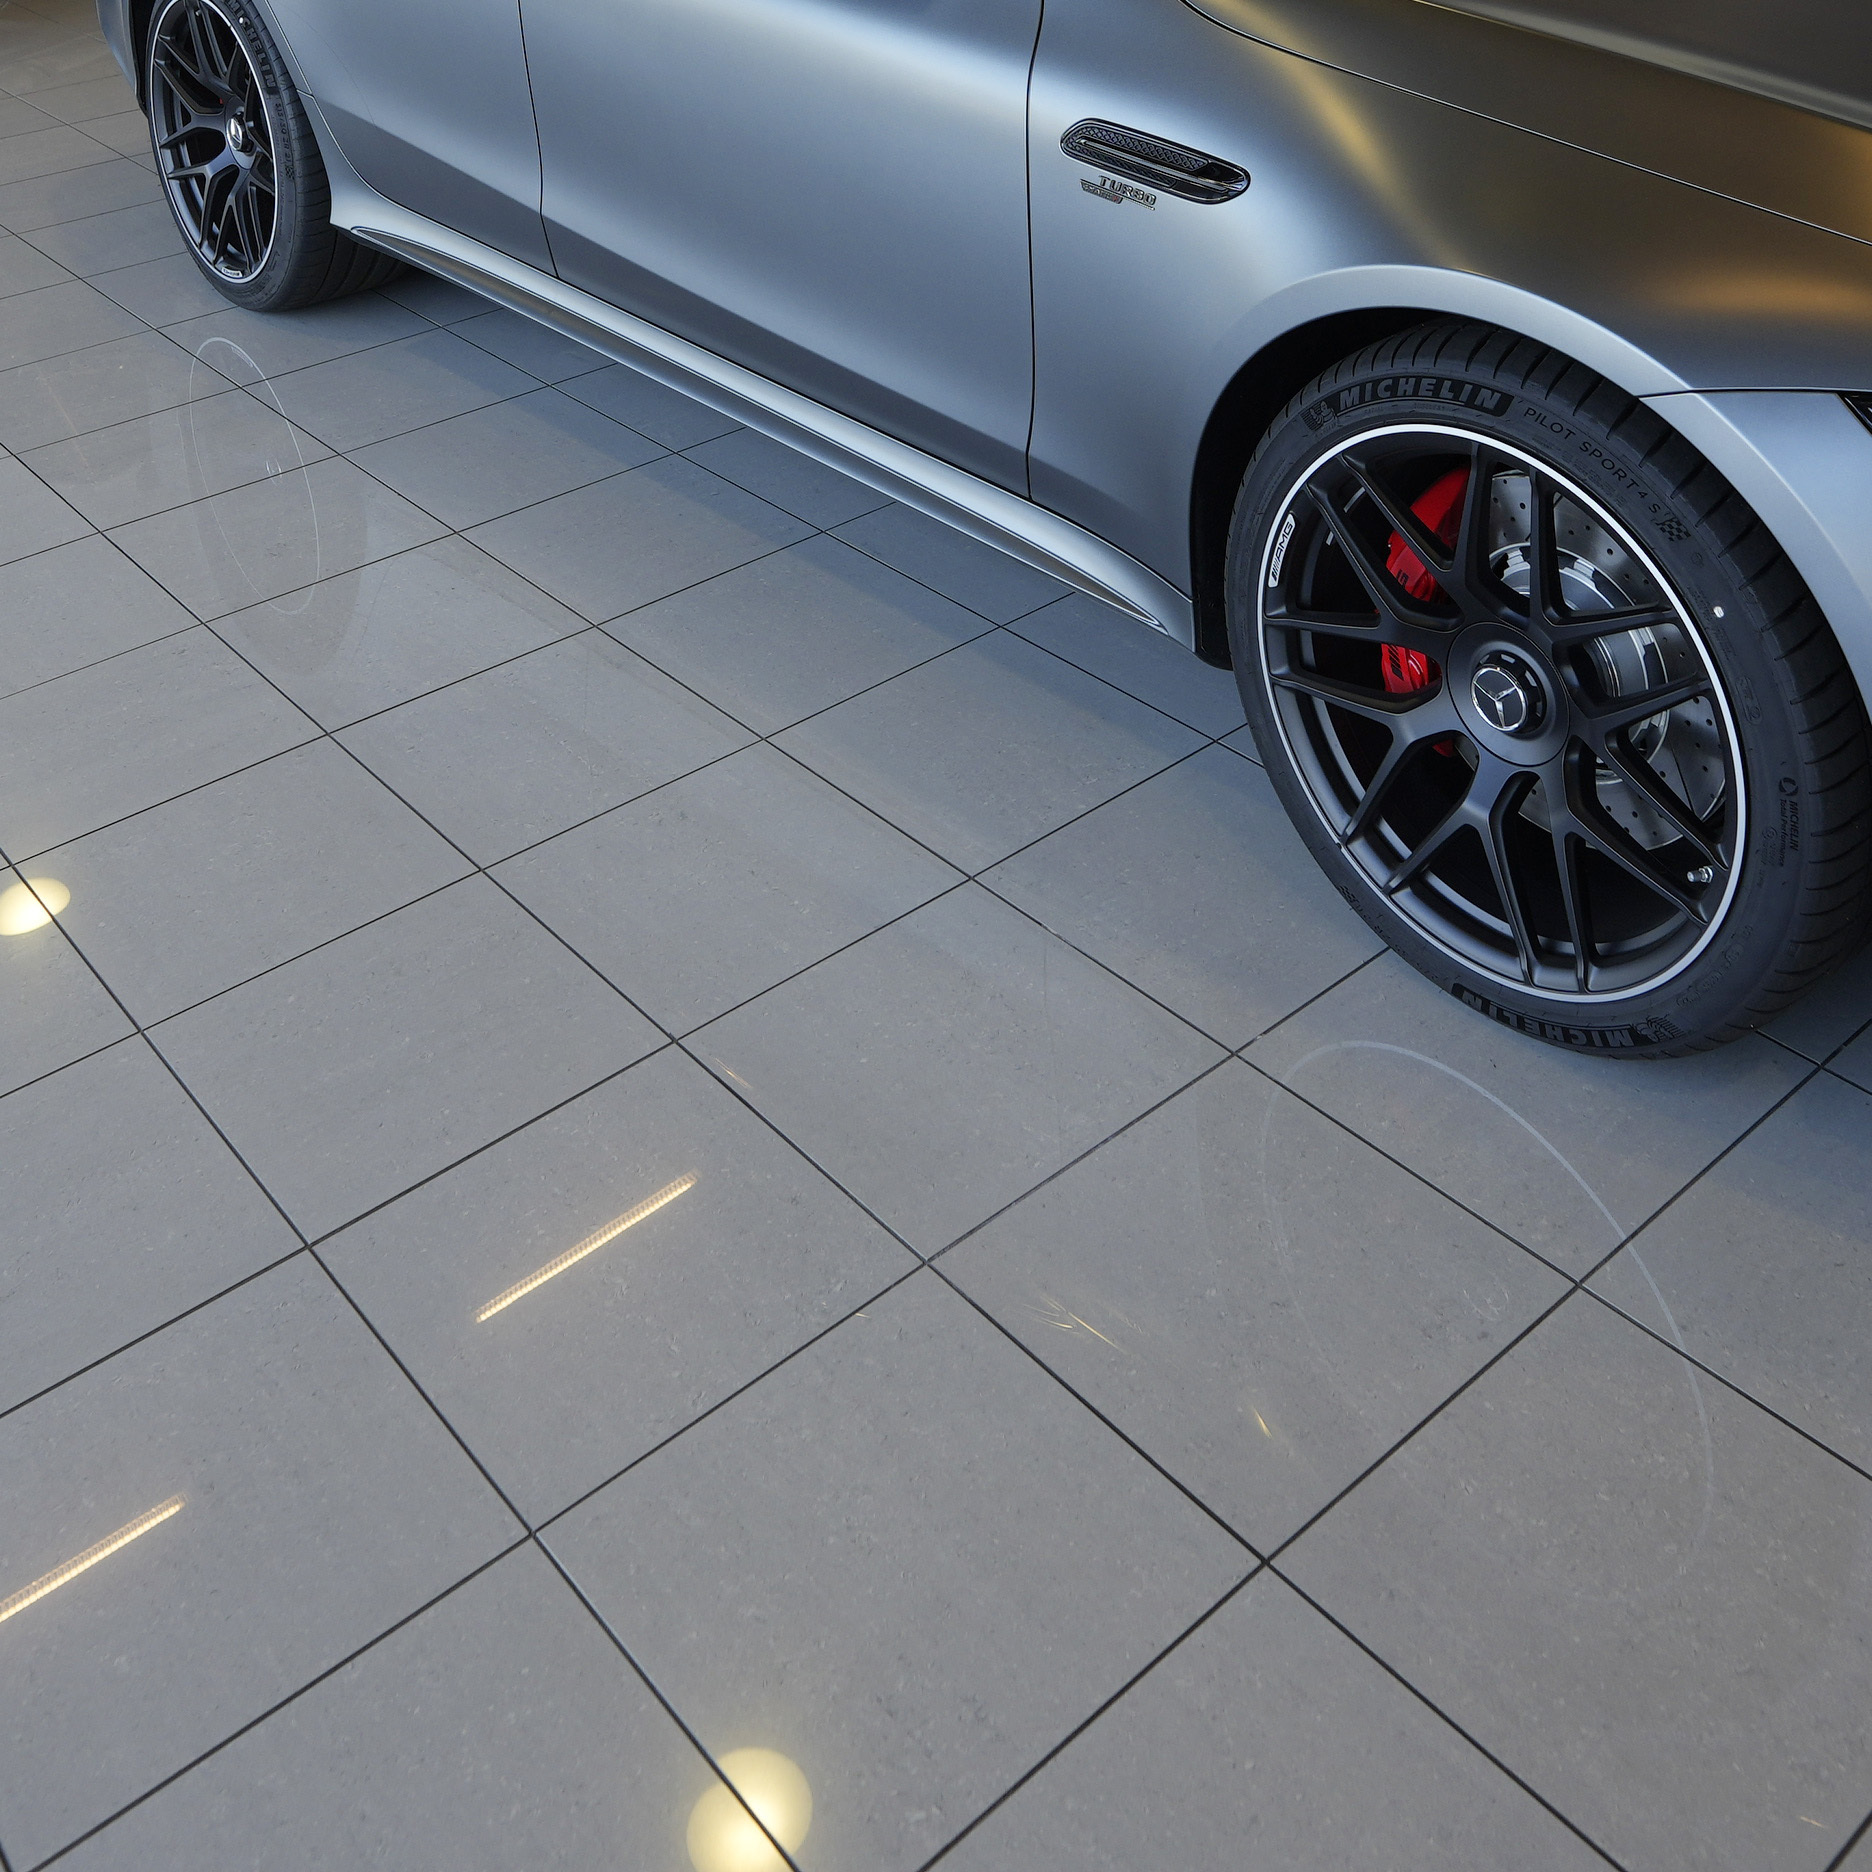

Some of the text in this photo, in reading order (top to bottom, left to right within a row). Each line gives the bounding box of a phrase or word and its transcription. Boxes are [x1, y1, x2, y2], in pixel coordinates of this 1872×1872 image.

[1098, 175, 1157, 206] TURBO
[1339, 377, 1502, 411] MICHELIN
[1523, 407, 1661, 514] PILOT SPORT 4 S
[1788, 799, 1799, 852] MICHELIN
[1460, 990, 1635, 1048] MICHELIN
